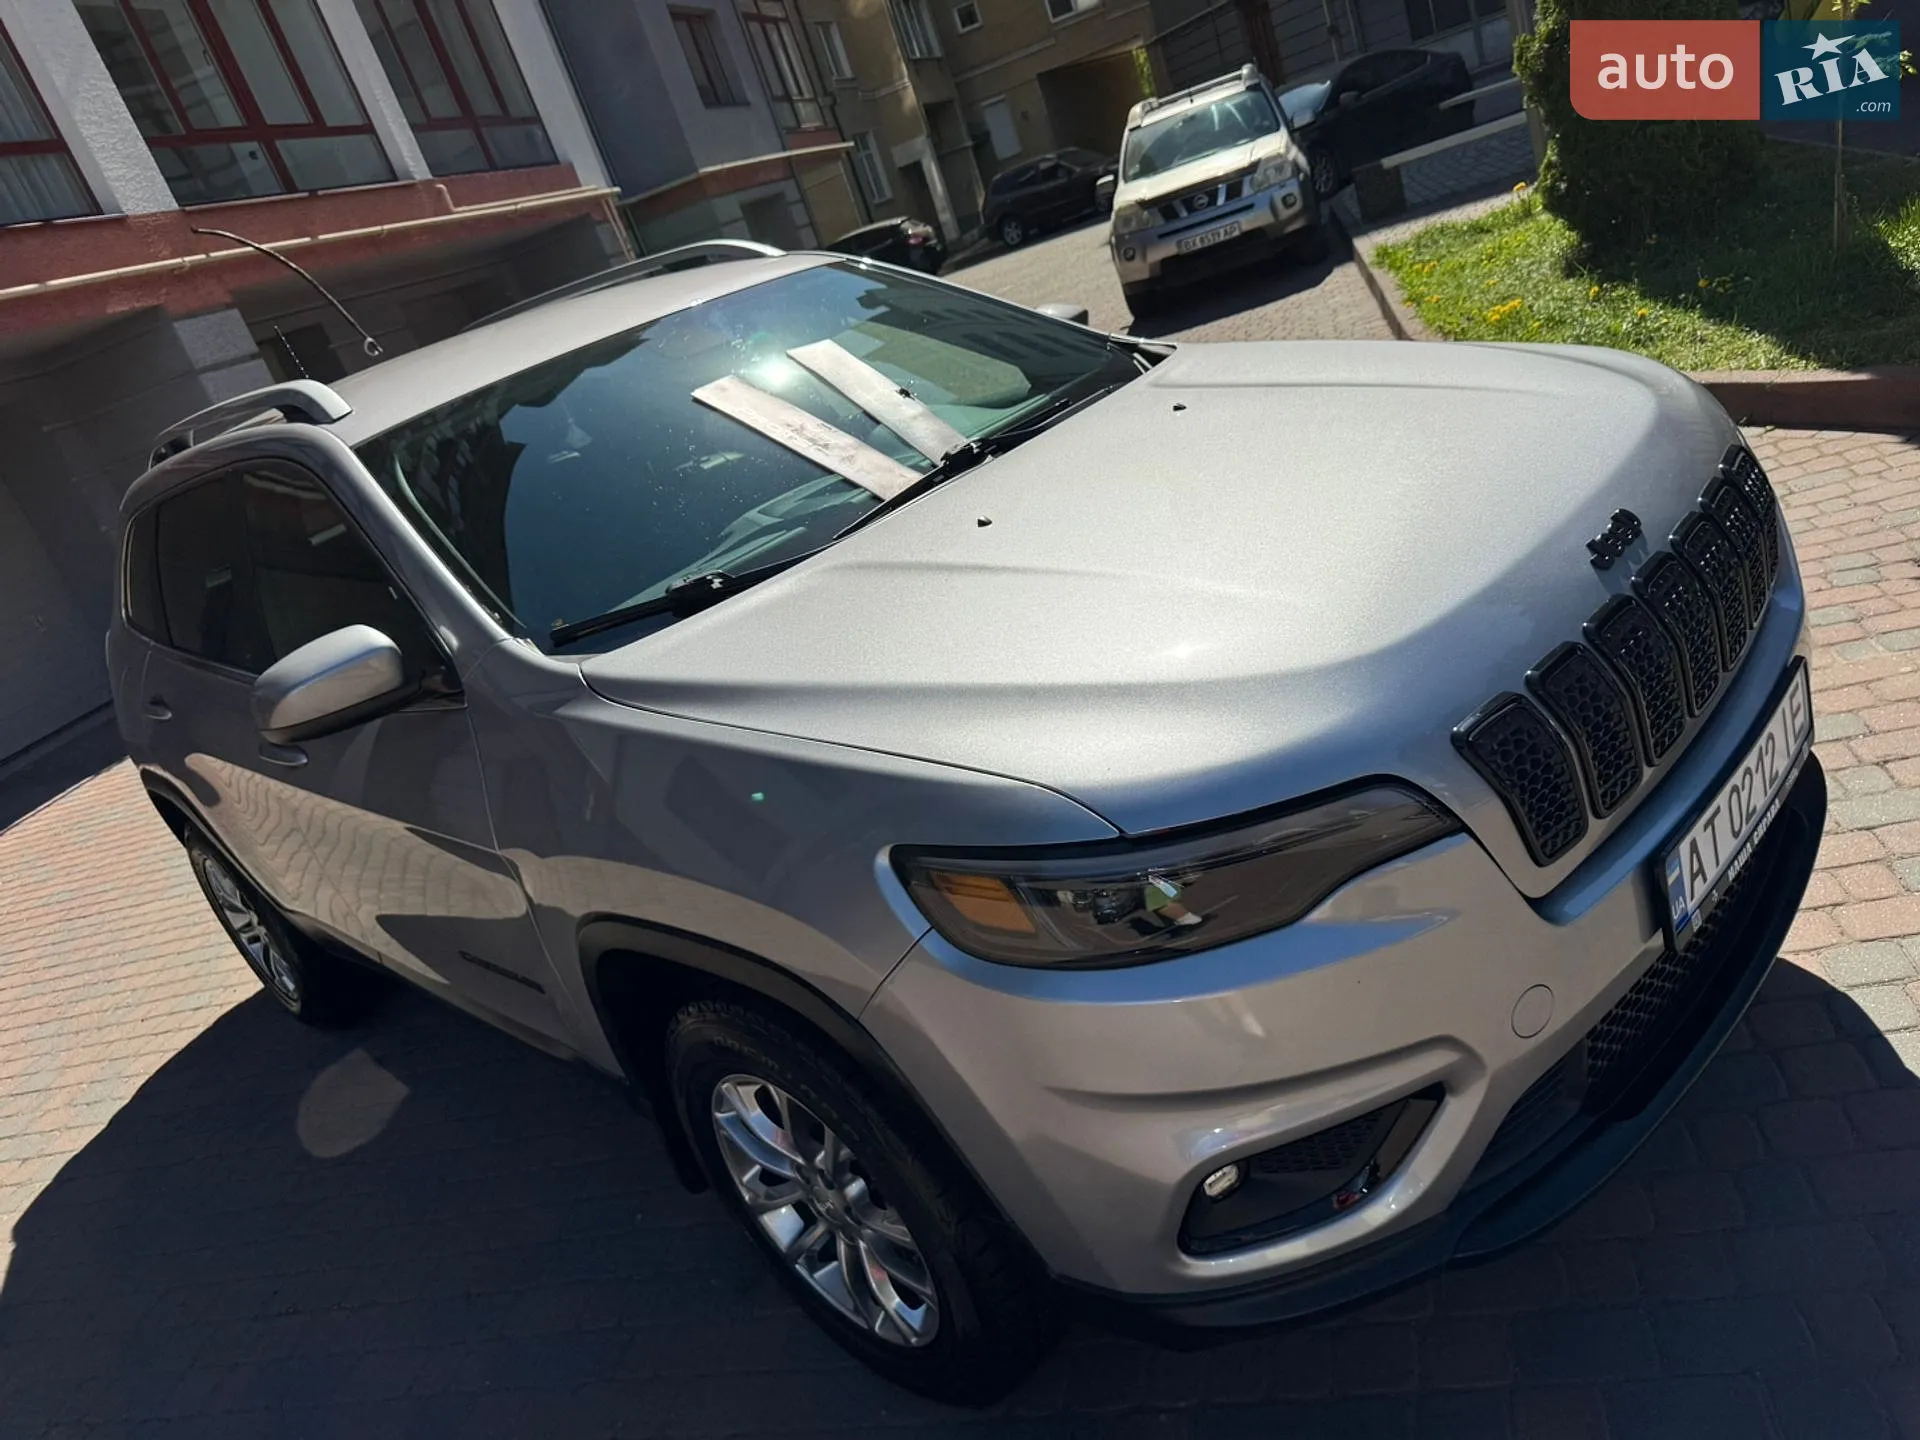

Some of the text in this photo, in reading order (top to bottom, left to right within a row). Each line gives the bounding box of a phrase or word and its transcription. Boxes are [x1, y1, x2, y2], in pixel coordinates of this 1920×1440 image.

[1688, 804, 1722, 901] AT
[1727, 731, 1780, 840] 0212
[1782, 680, 1806, 760] IE
[1671, 895, 1686, 920] UA
